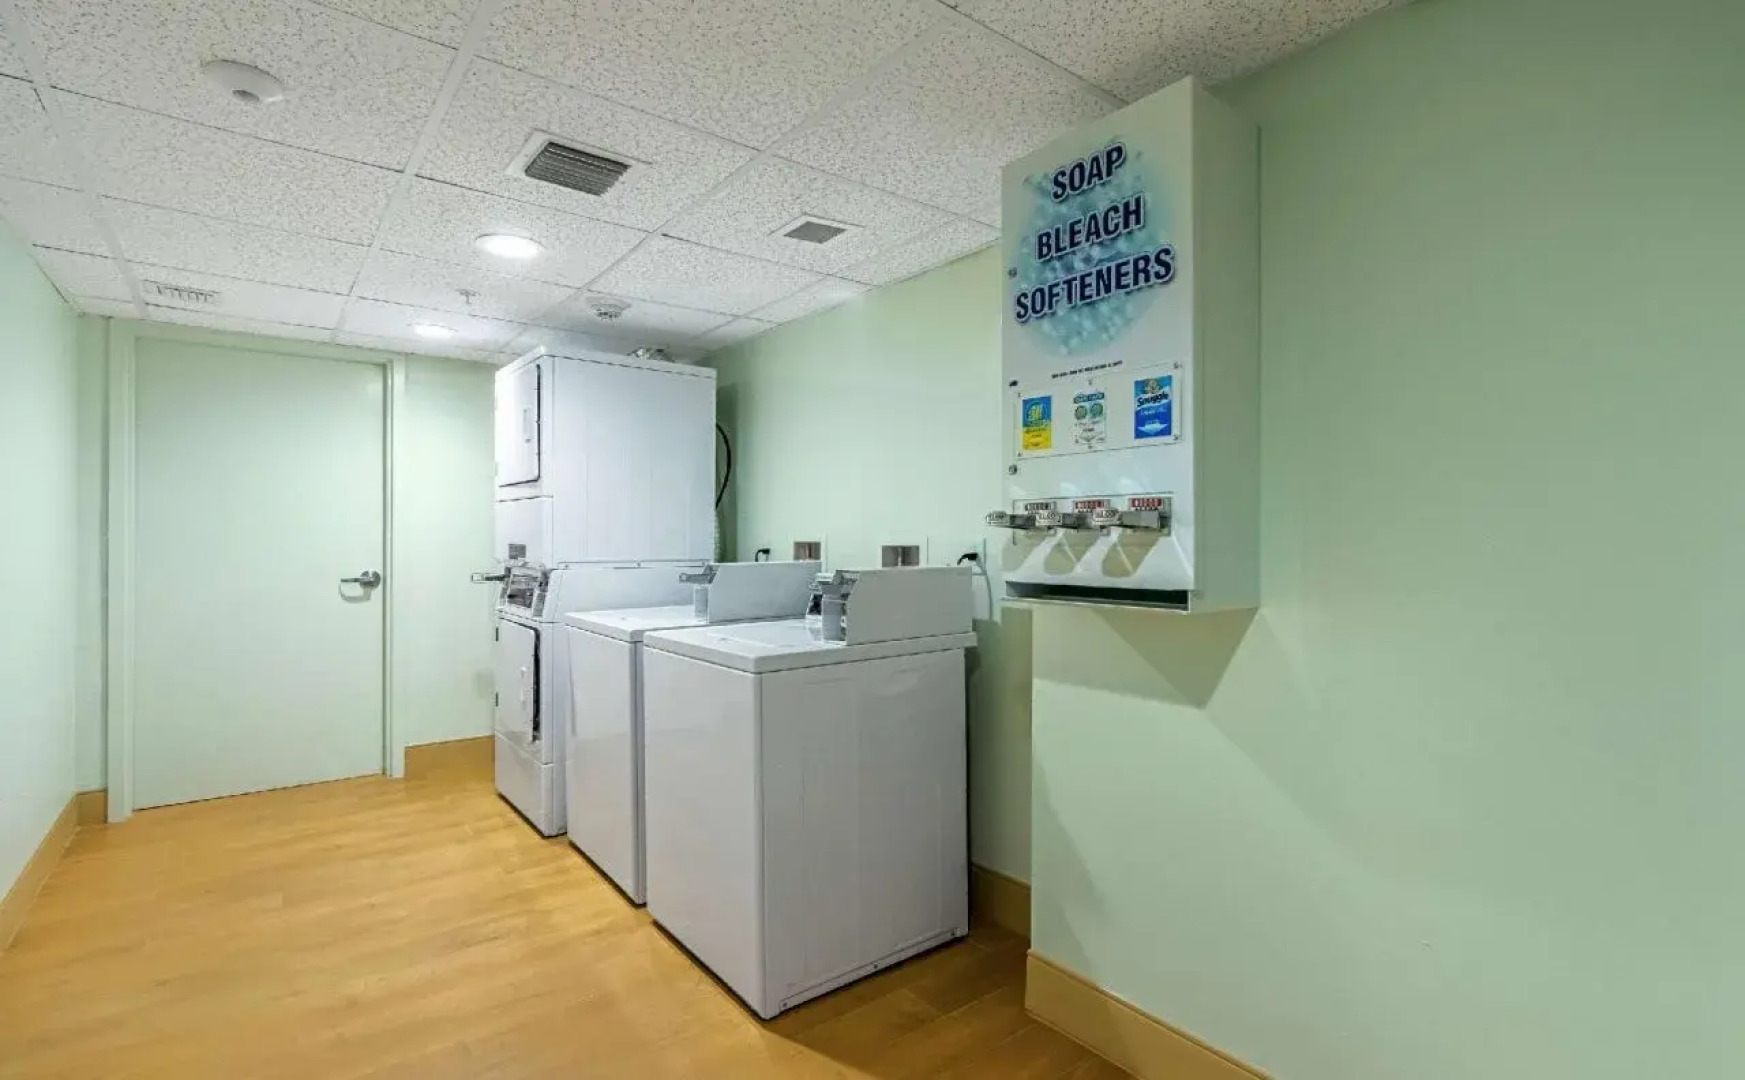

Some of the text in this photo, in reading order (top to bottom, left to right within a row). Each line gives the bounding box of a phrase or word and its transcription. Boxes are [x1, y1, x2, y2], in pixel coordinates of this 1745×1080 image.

[1052, 144, 1125, 200] SOAP
[1037, 193, 1144, 261] BLEACH
[1015, 245, 1174, 322] SOFTENERS
[1136, 392, 1169, 407] Snuggle
